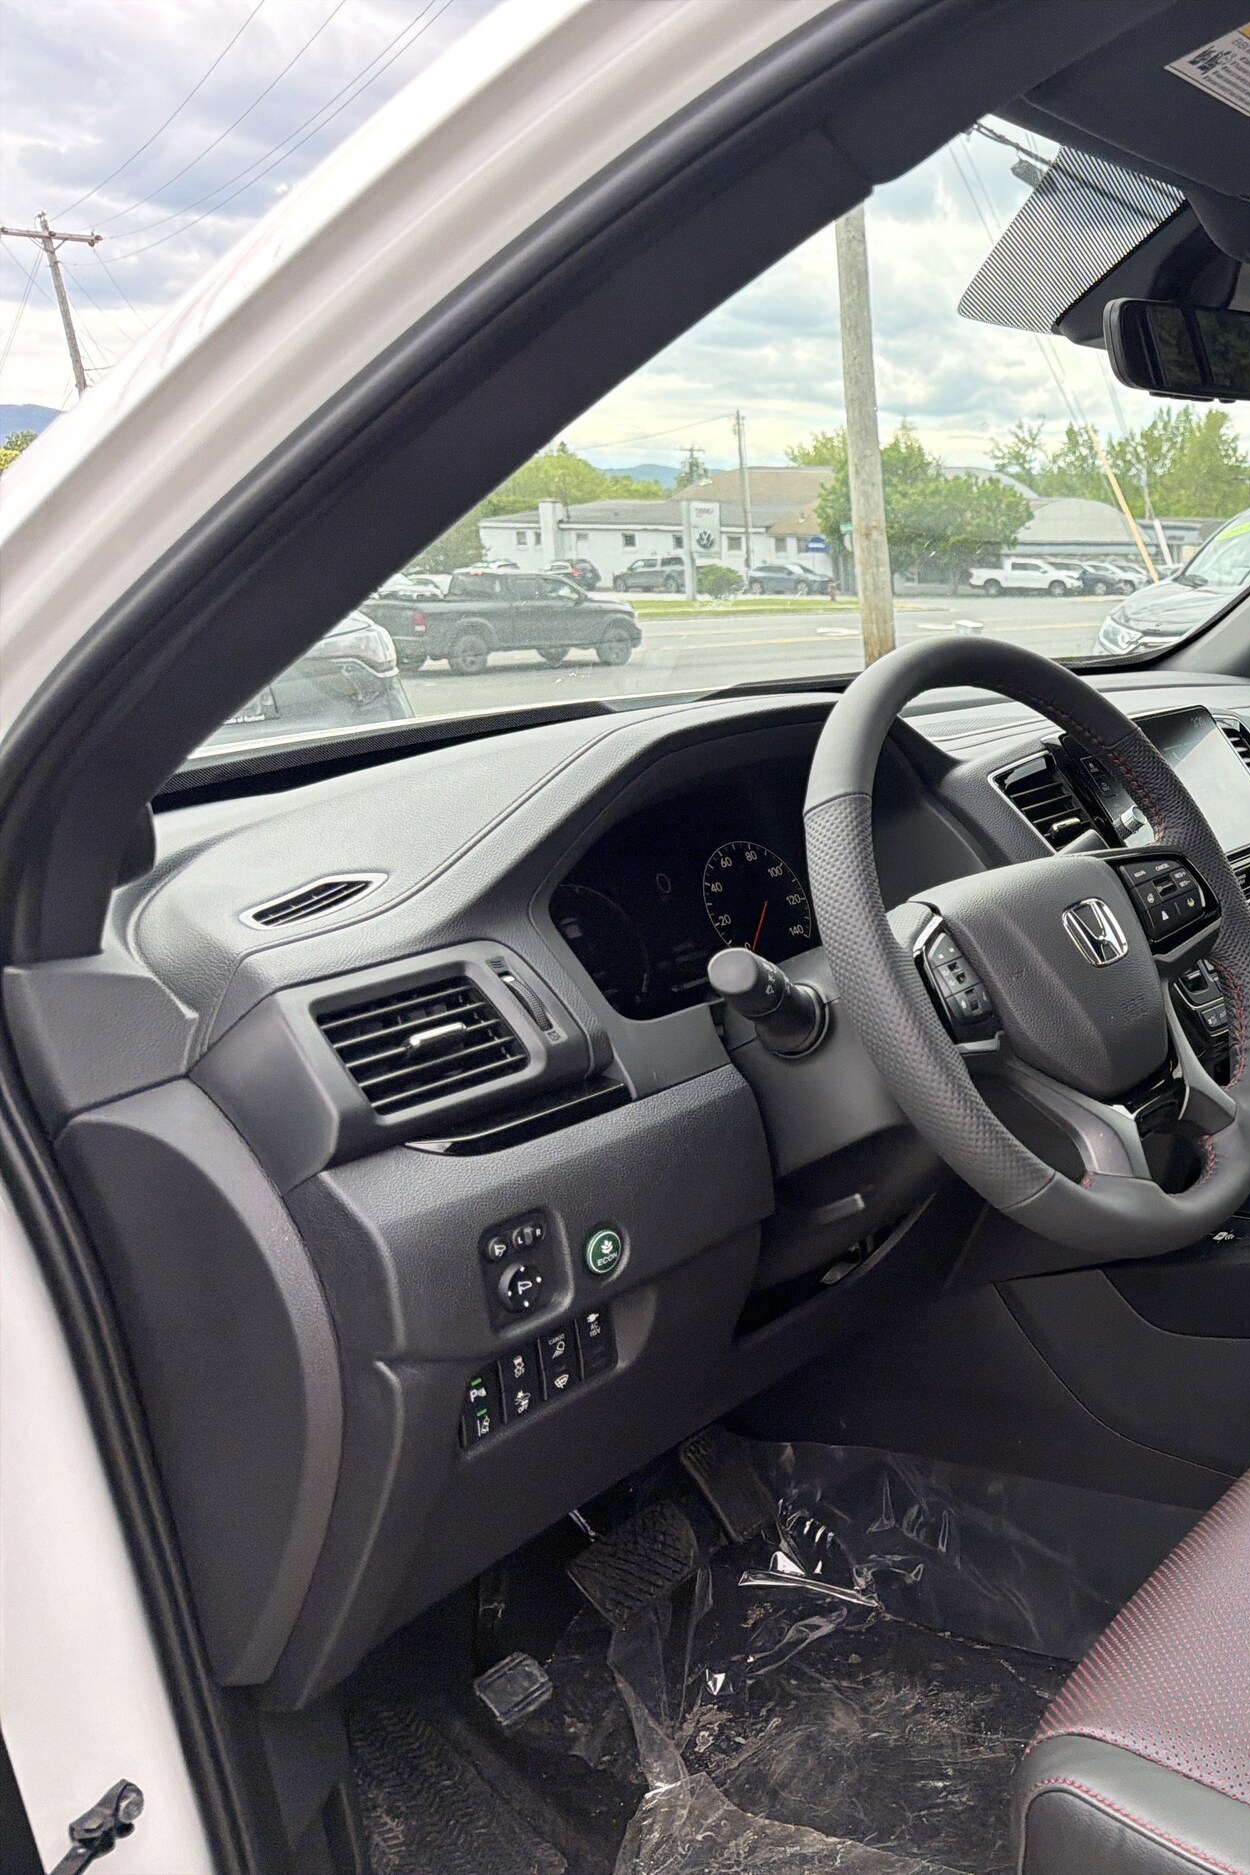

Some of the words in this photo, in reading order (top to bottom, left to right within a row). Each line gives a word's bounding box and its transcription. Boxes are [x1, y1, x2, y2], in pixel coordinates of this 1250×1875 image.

[745, 851, 757, 861] 80
[721, 857, 732, 868] 60
[768, 866, 783, 877] 100
[711, 882, 723, 893] 40
[786, 894, 801, 905] 120
[719, 914, 731, 926] 20
[789, 925, 804, 936] 140
[535, 1228, 541, 1237] R
[597, 1251, 618, 1267] ECON
[591, 1321, 599, 1330] AC
[548, 1333, 565, 1345] CARGO
